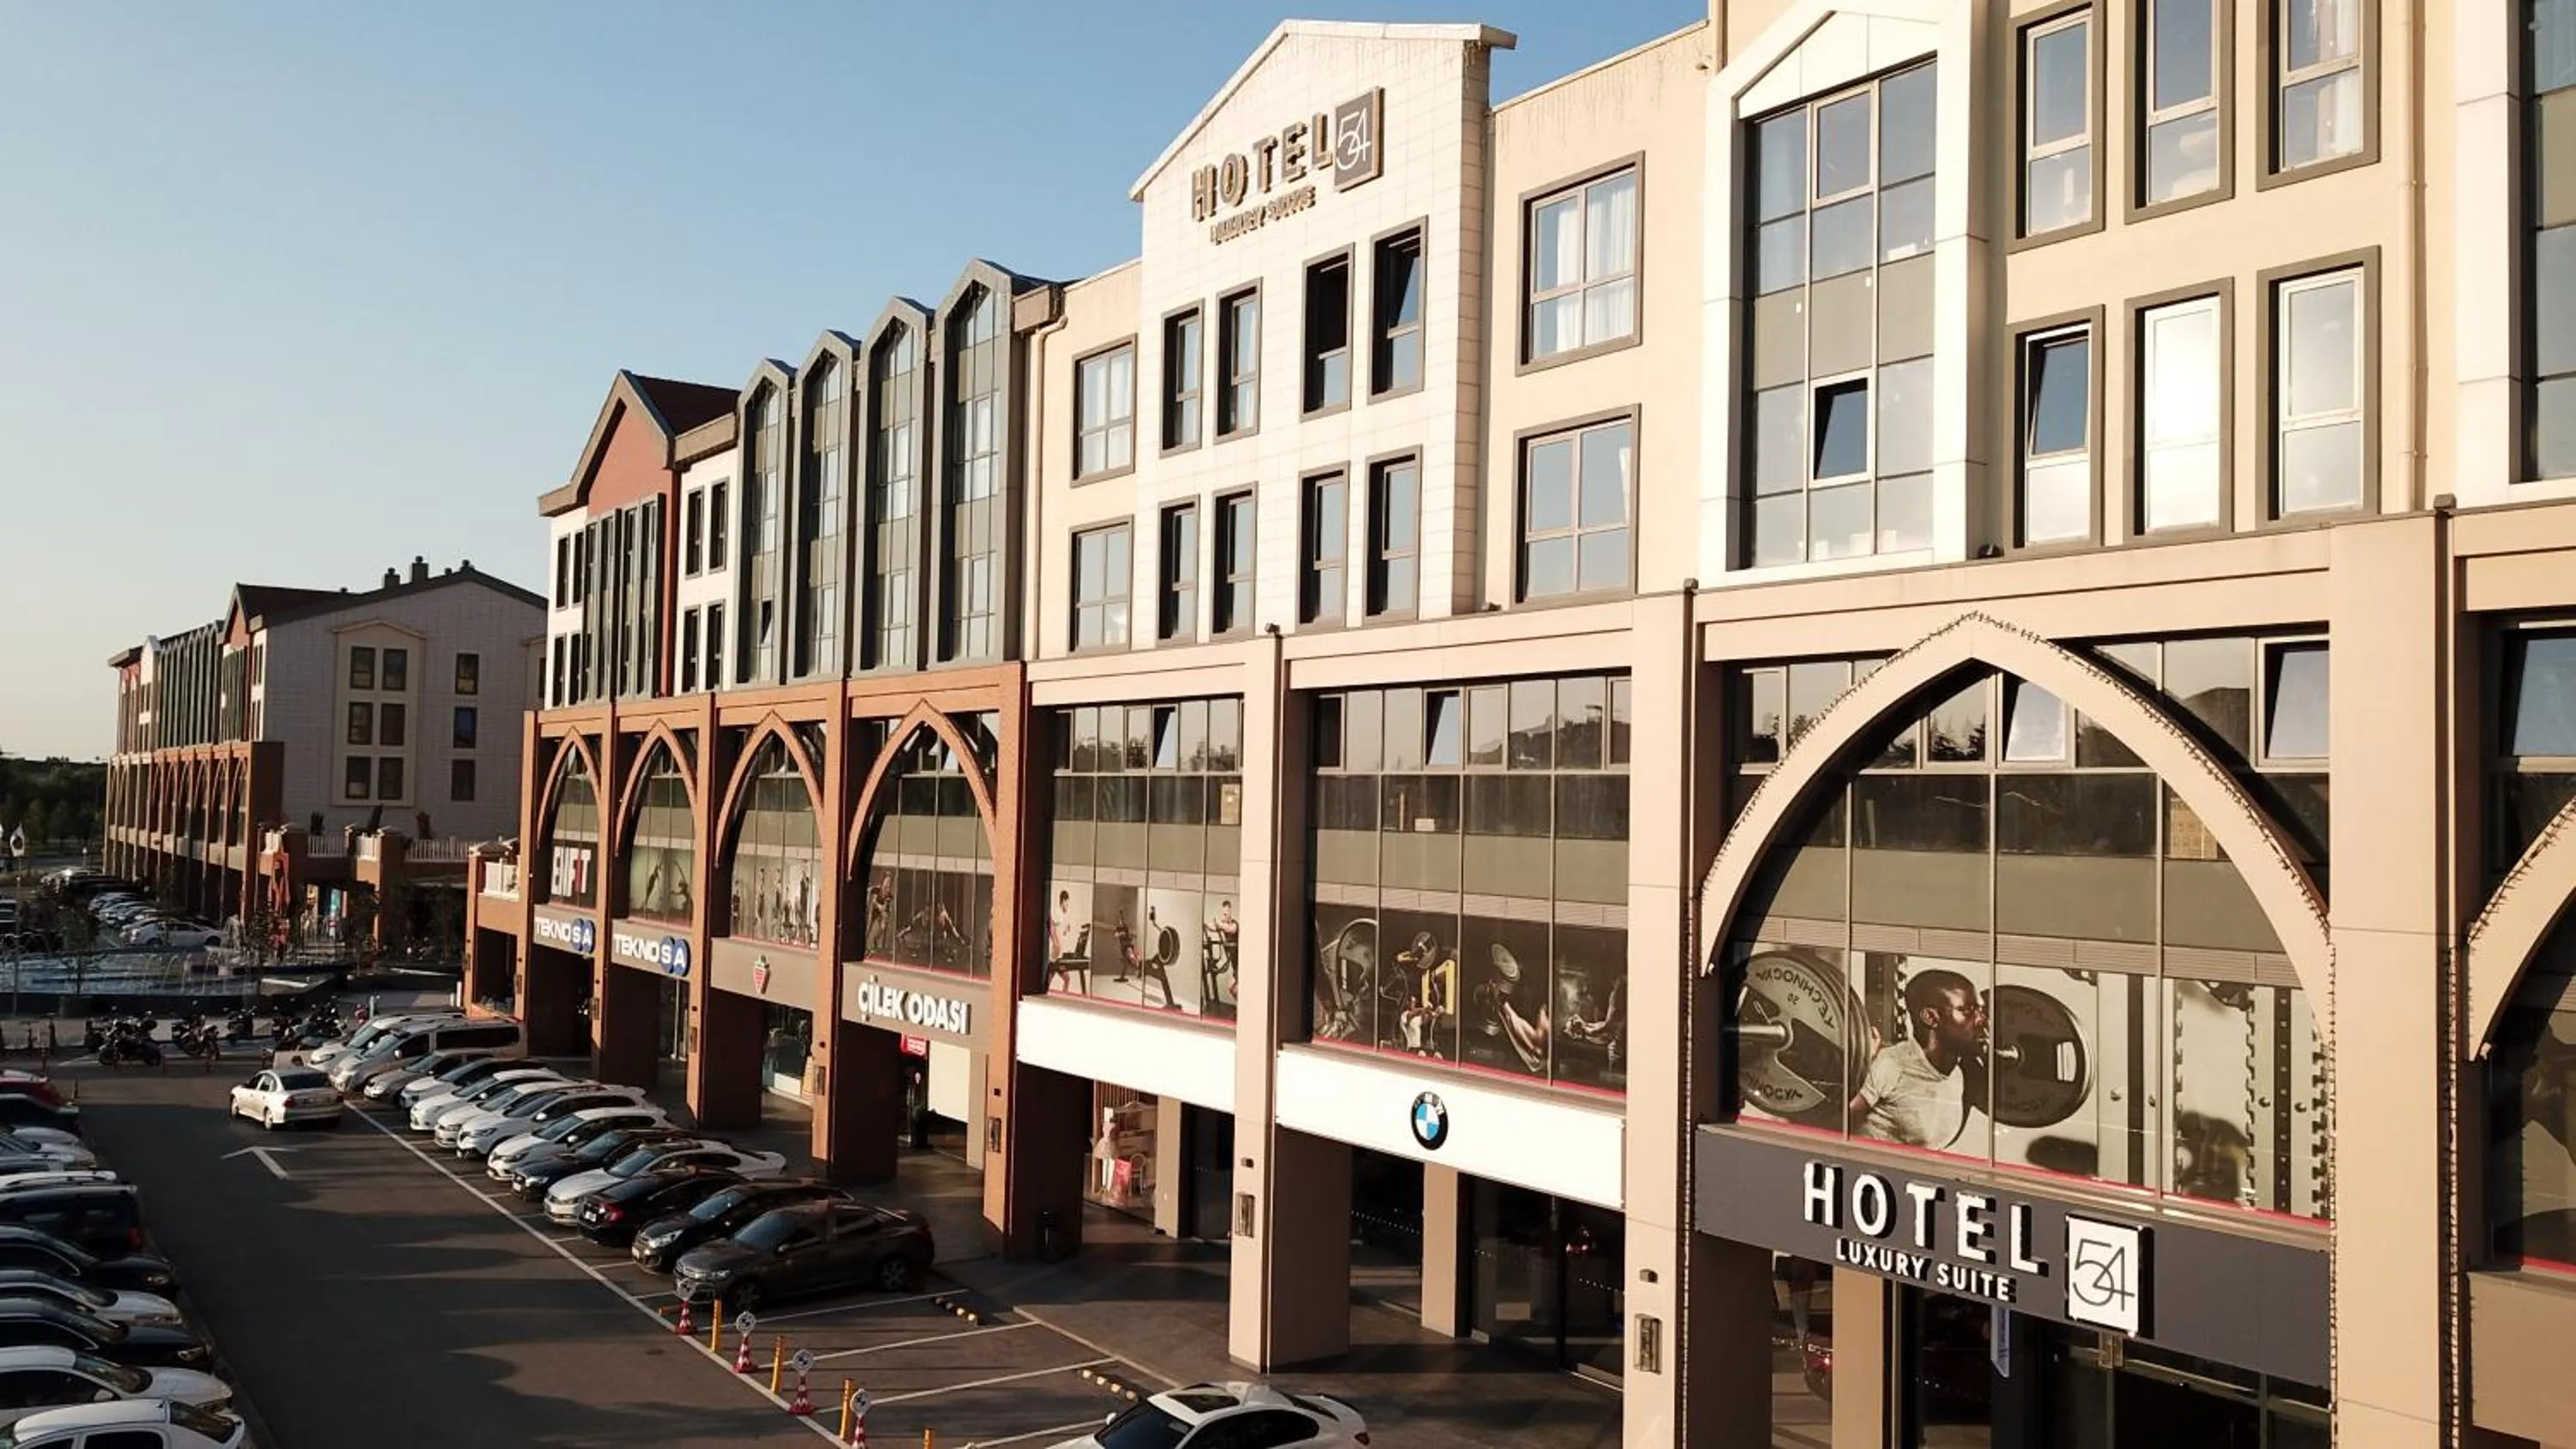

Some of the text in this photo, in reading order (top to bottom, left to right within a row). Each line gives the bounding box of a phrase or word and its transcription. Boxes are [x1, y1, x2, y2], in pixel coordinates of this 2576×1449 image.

[1192, 106, 1371, 222] HOTEL 54
[534, 916, 595, 948] TEKNOSA
[613, 933, 687, 970] TEKNOSA
[858, 974, 969, 1034] ÇİLEK ODASI
[1804, 1161, 2136, 1313] HOTEL 54
[1836, 1237, 2012, 1303] LUXURY SUITE
